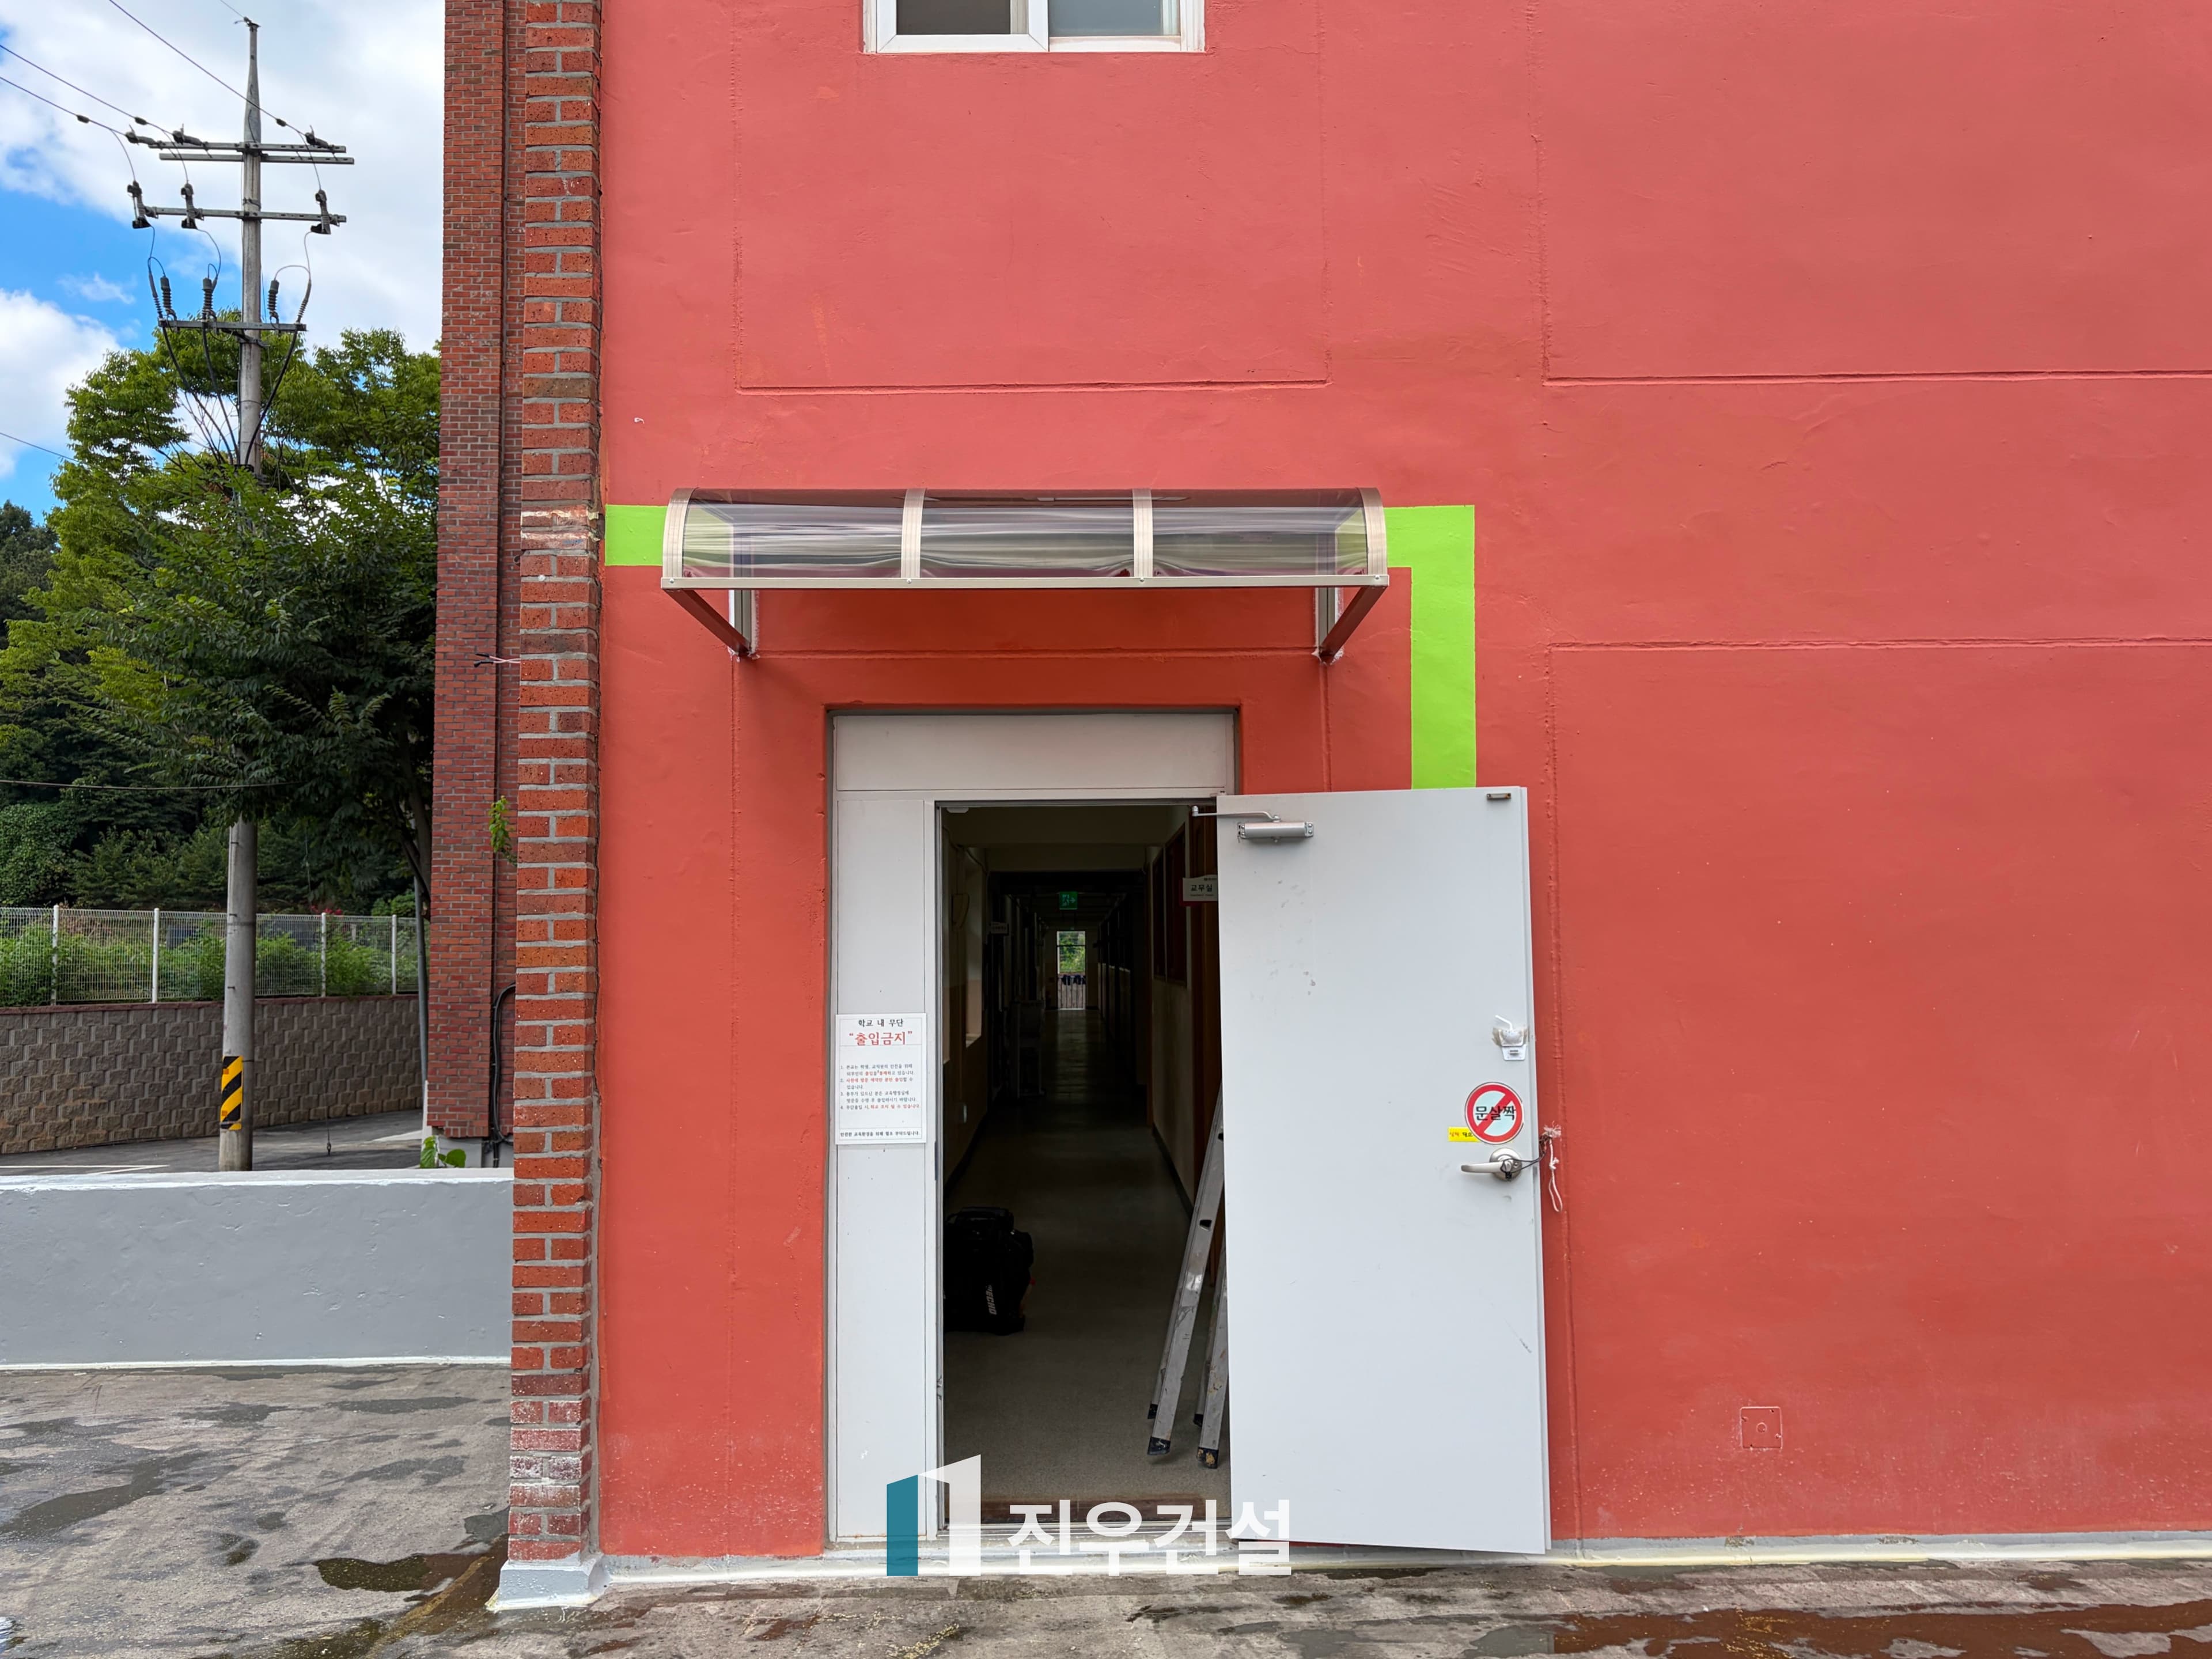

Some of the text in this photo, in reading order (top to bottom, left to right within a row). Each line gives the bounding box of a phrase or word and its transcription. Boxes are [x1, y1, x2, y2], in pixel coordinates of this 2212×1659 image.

[1190, 884, 1213, 892] 교무실
[858, 1018, 904, 1028] 학교 내 무단
[1475, 1106, 1517, 1120] 문살짝
